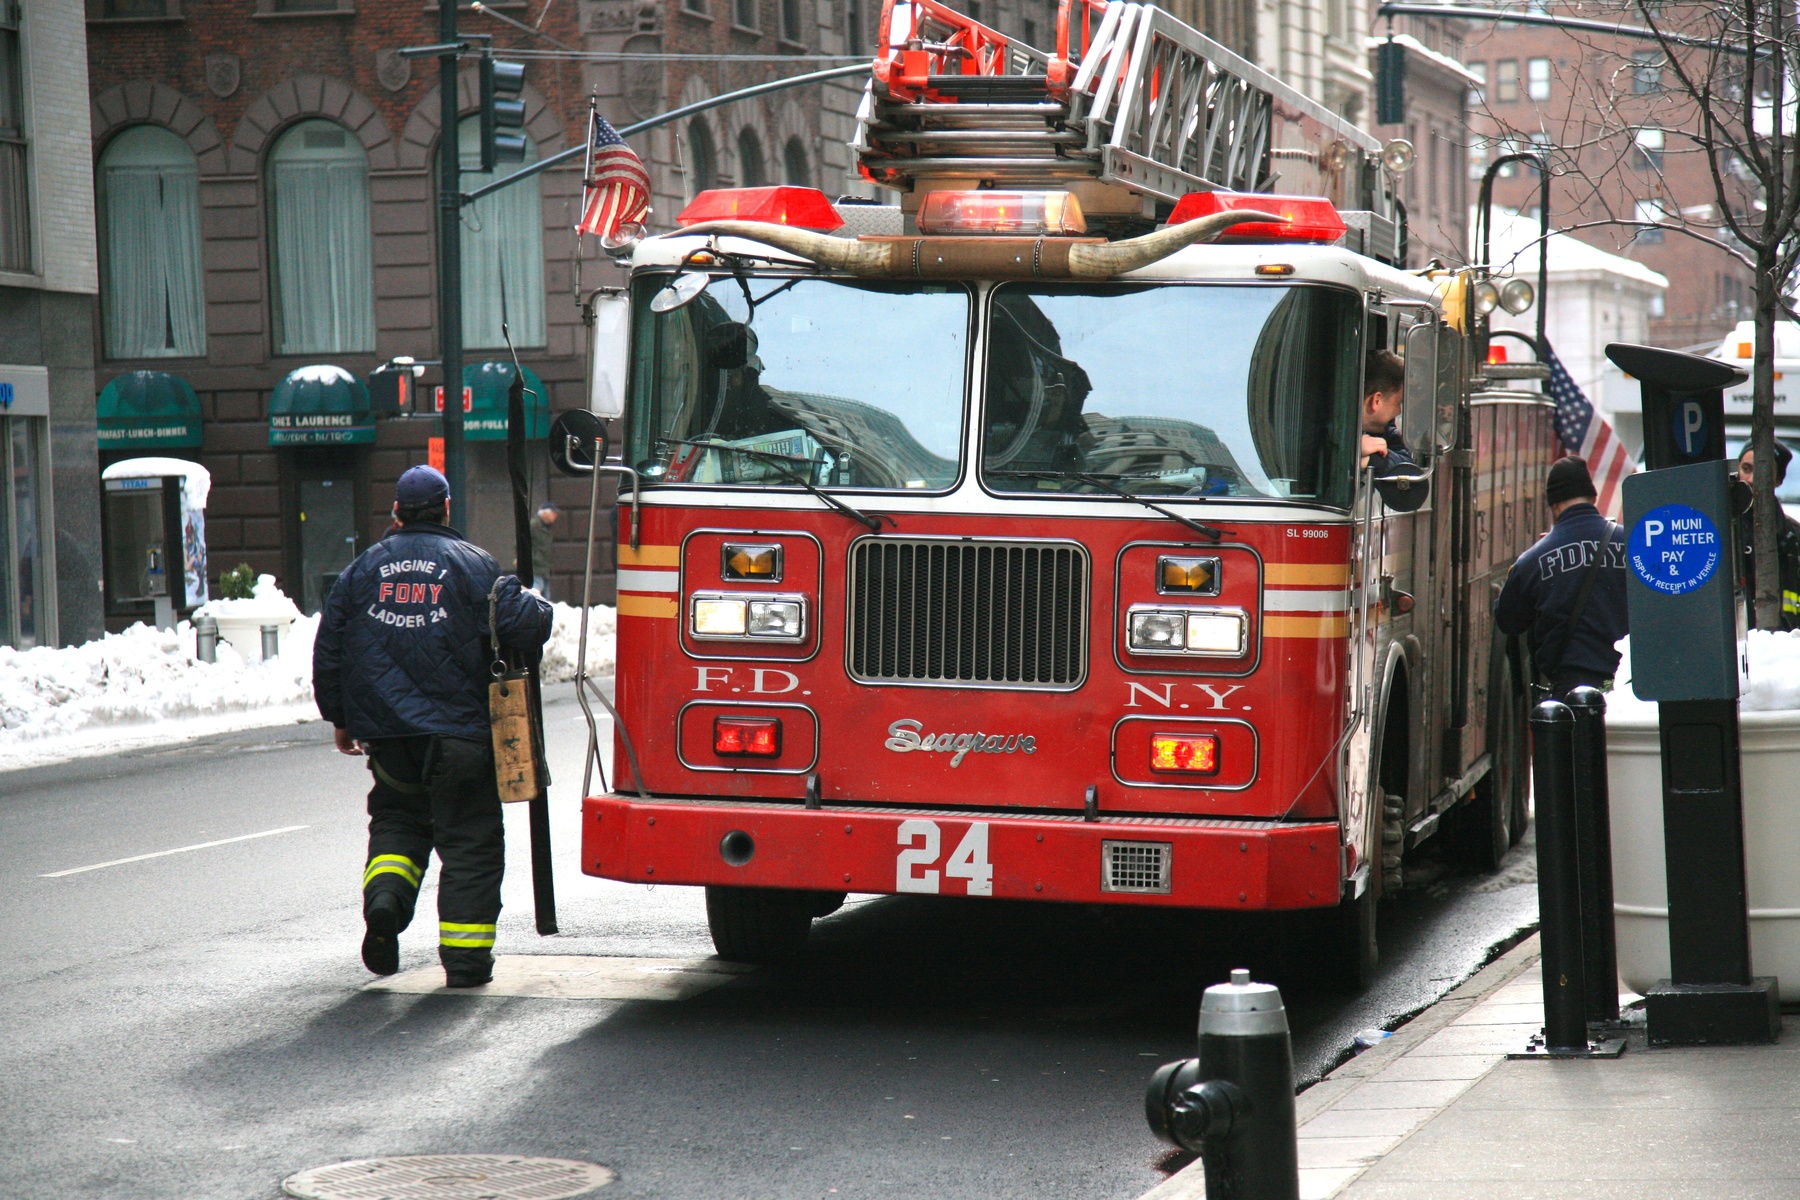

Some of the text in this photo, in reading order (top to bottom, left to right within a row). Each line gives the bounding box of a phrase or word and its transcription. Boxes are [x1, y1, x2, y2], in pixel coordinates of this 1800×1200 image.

[295, 415, 353, 427] LAURENCE
[1683, 402, 1703, 453] P
[121, 479, 148, 489] TITAN
[1286, 528, 1300, 538] SL
[1645, 518, 1702, 547] P MUNI
[1672, 532, 1715, 546] METER
[1538, 540, 1627, 580] FDNY
[1661, 550, 1686, 563] PAY
[379, 559, 448, 580] ENGINE 1
[1633, 551, 1717, 591] DISPLAY RECEIPT IN VEHICLE
[379, 582, 443, 605] FDNY
[367, 603, 448, 628] LADDER 24
[885, 718, 1038, 768] Seagrave
[896, 819, 994, 897] 24
